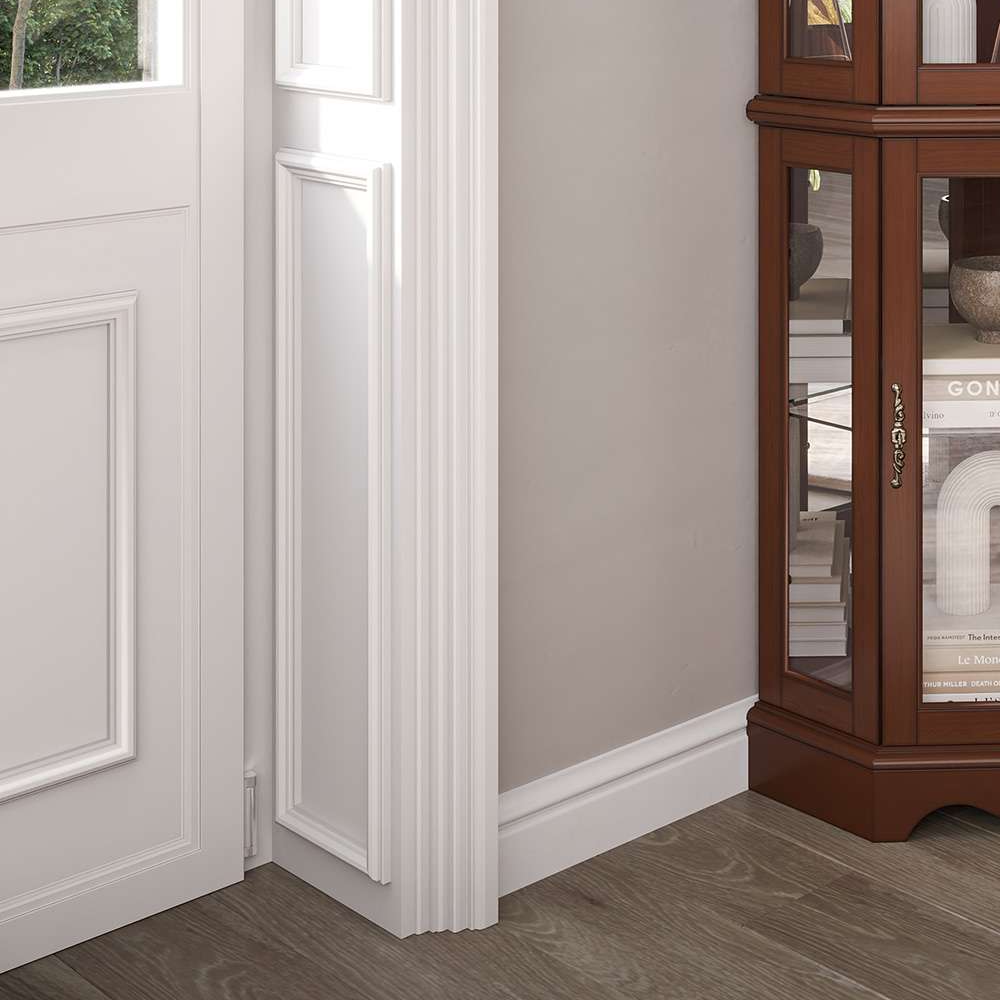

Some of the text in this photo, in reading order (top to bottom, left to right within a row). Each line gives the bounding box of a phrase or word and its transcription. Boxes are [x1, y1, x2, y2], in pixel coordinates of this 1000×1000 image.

[967, 633, 982, 641] The
[958, 655, 971, 665] Le
[971, 680, 993, 688] DEATH
